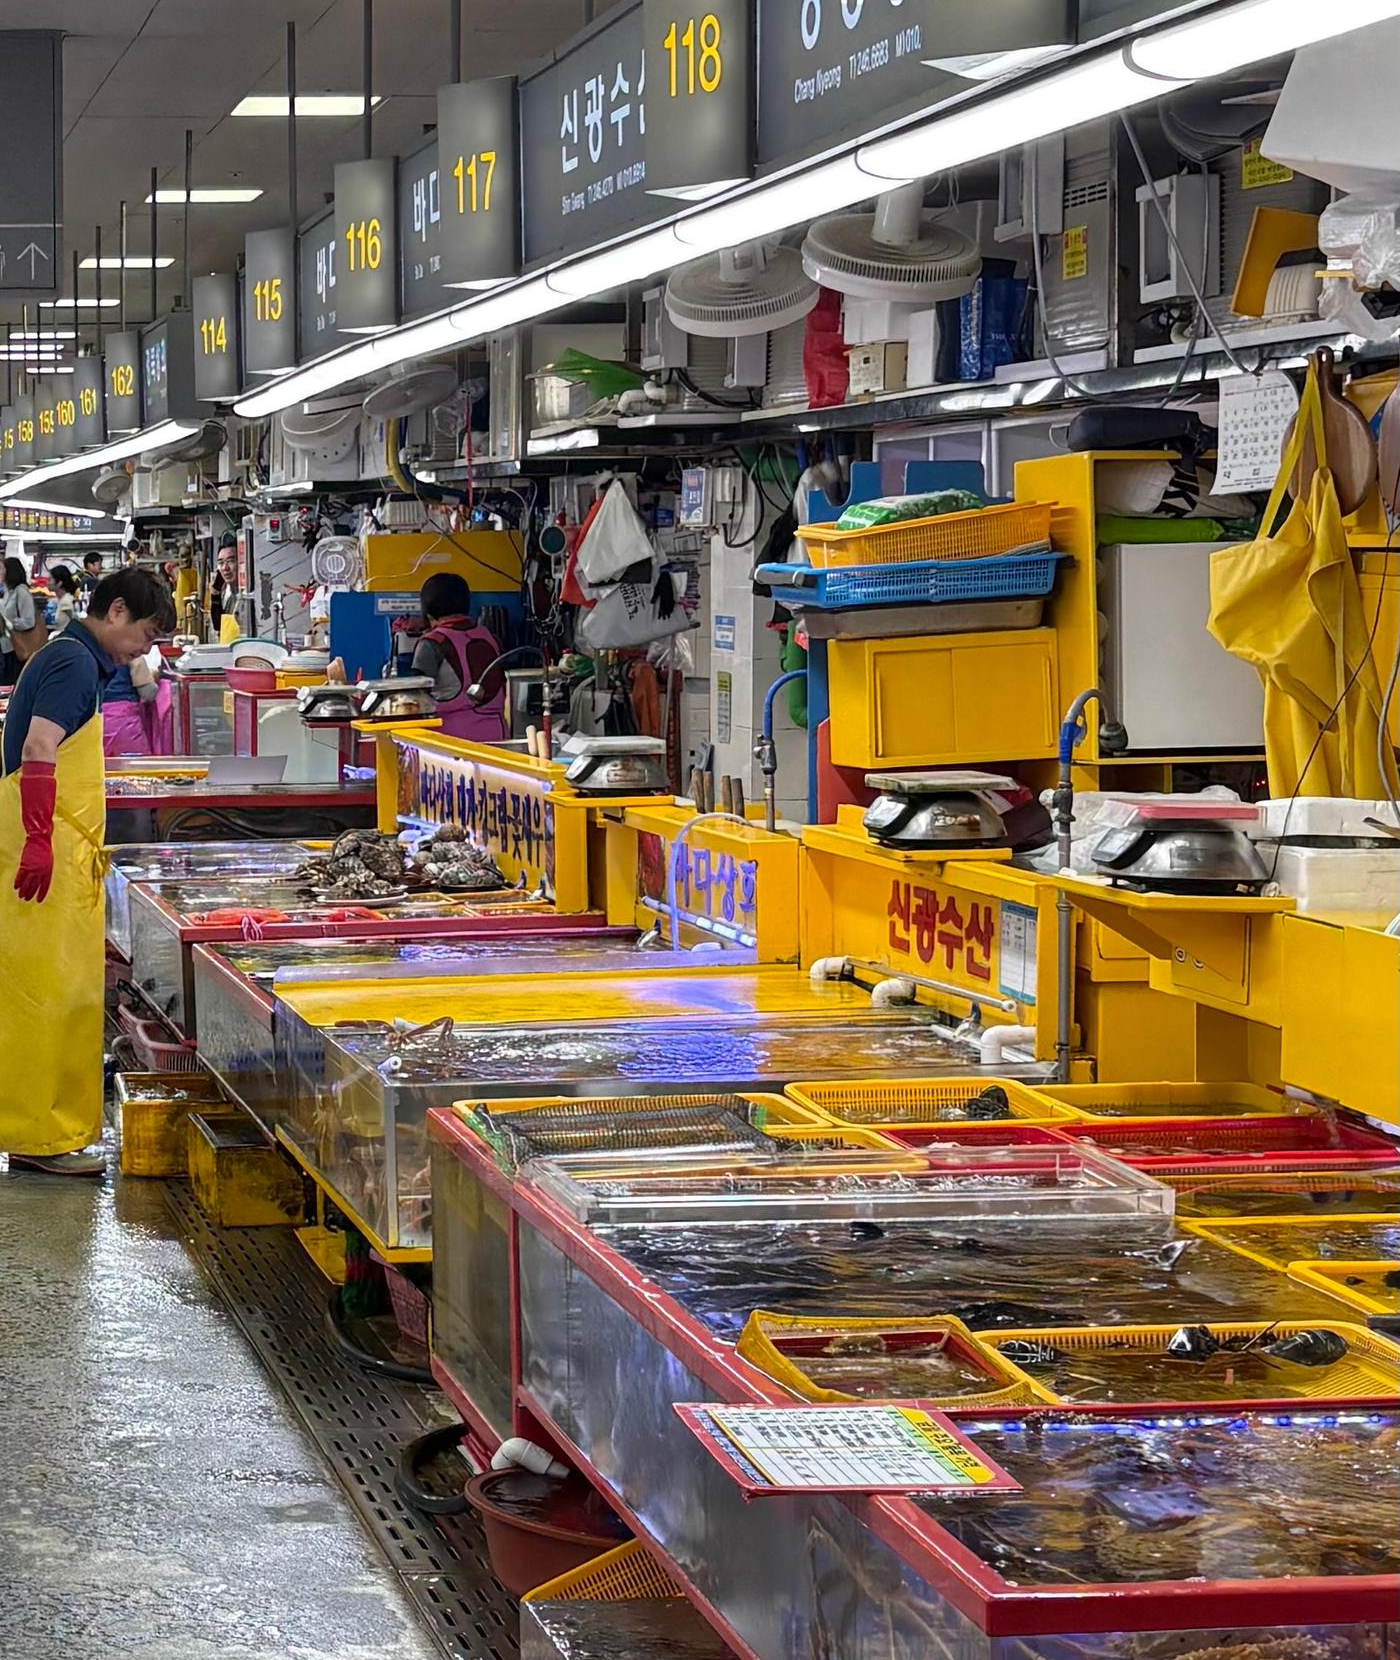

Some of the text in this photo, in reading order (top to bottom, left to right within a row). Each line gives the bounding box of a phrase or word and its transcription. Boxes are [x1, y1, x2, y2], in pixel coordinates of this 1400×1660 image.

[662, 13, 723, 99] 118
[794, 78, 815, 104] Chang
[816, 65, 841, 96] Nyeong
[561, 48, 645, 173] 신광수
[453, 151, 496, 214] 117
[346, 218, 381, 271] 116
[254, 278, 282, 322] 115
[200, 315, 228, 355] 114
[111, 365, 133, 396] 162
[56, 400, 75, 426] 160
[80, 388, 97, 416] 161
[4, 428, 14, 449] 15
[18, 420, 33, 442] 158
[888, 879, 994, 981] 신광수산
